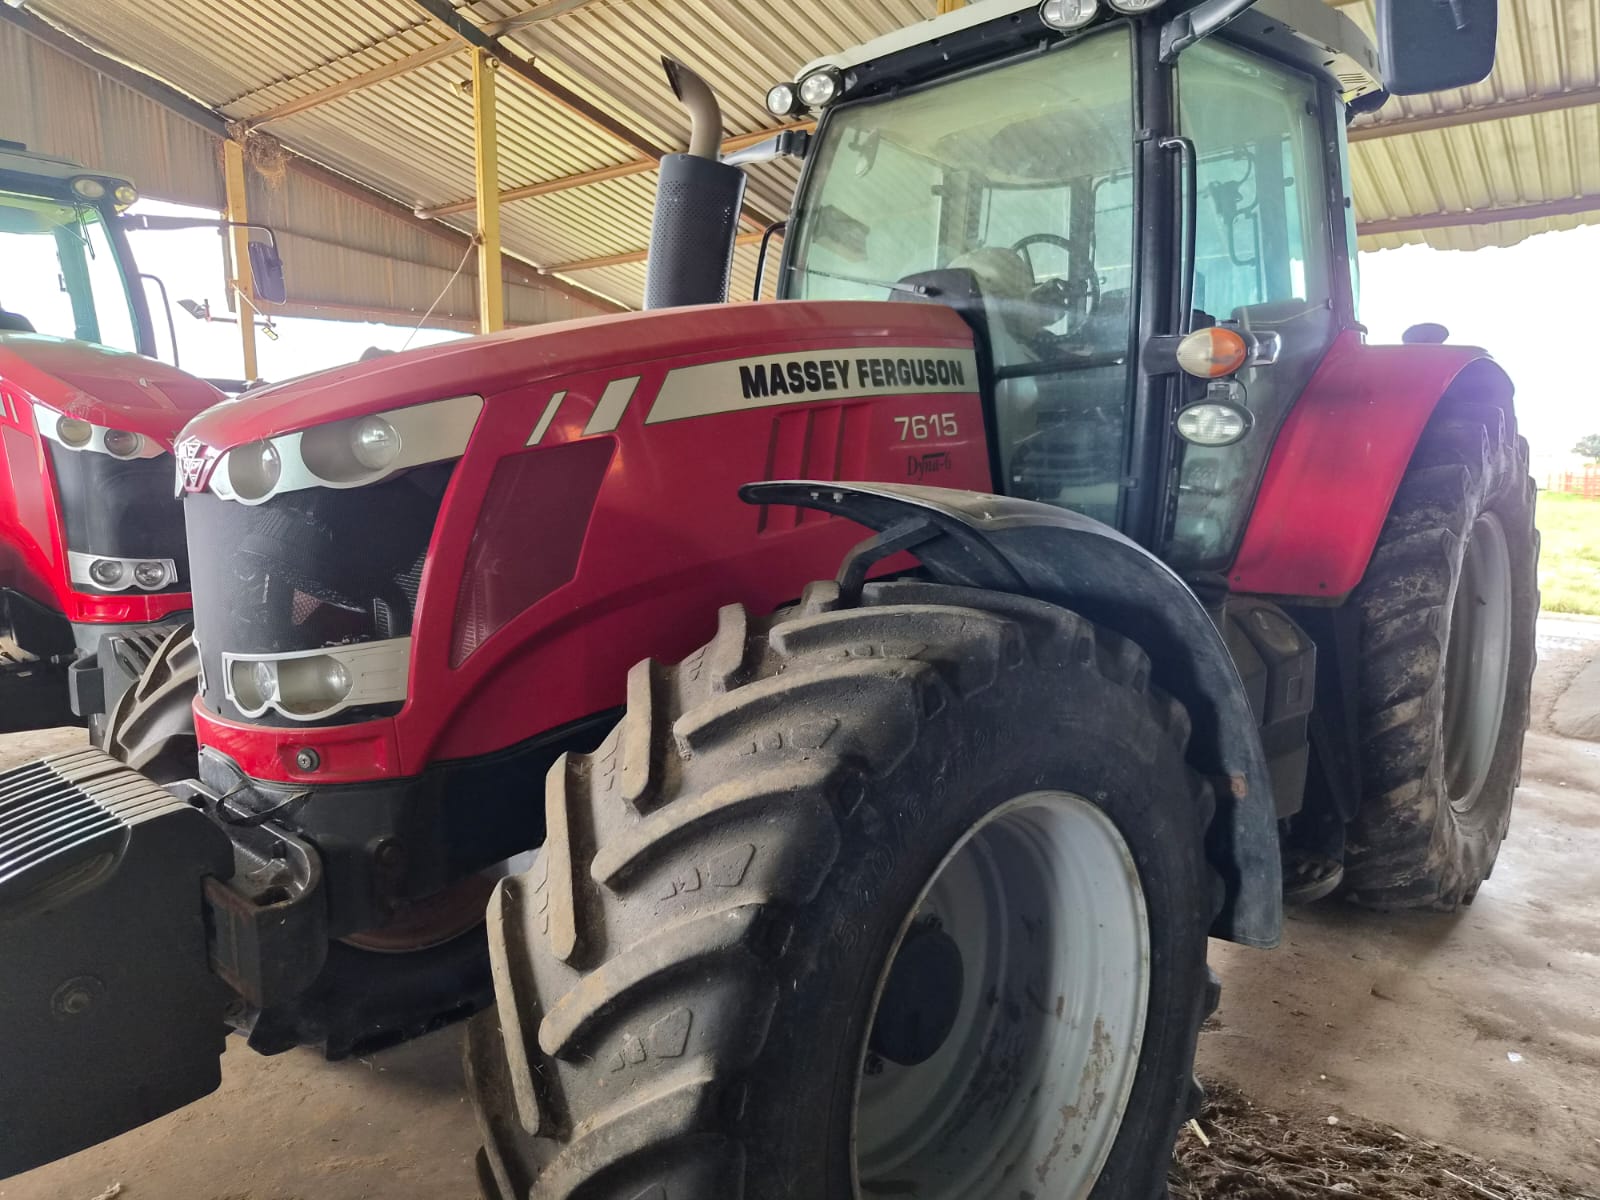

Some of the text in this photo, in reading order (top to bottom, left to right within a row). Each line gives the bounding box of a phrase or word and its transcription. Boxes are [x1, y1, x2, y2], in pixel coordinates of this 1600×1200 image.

[739, 358, 965, 399] MASSEY FERGUSON
[894, 413, 958, 441] 7615
